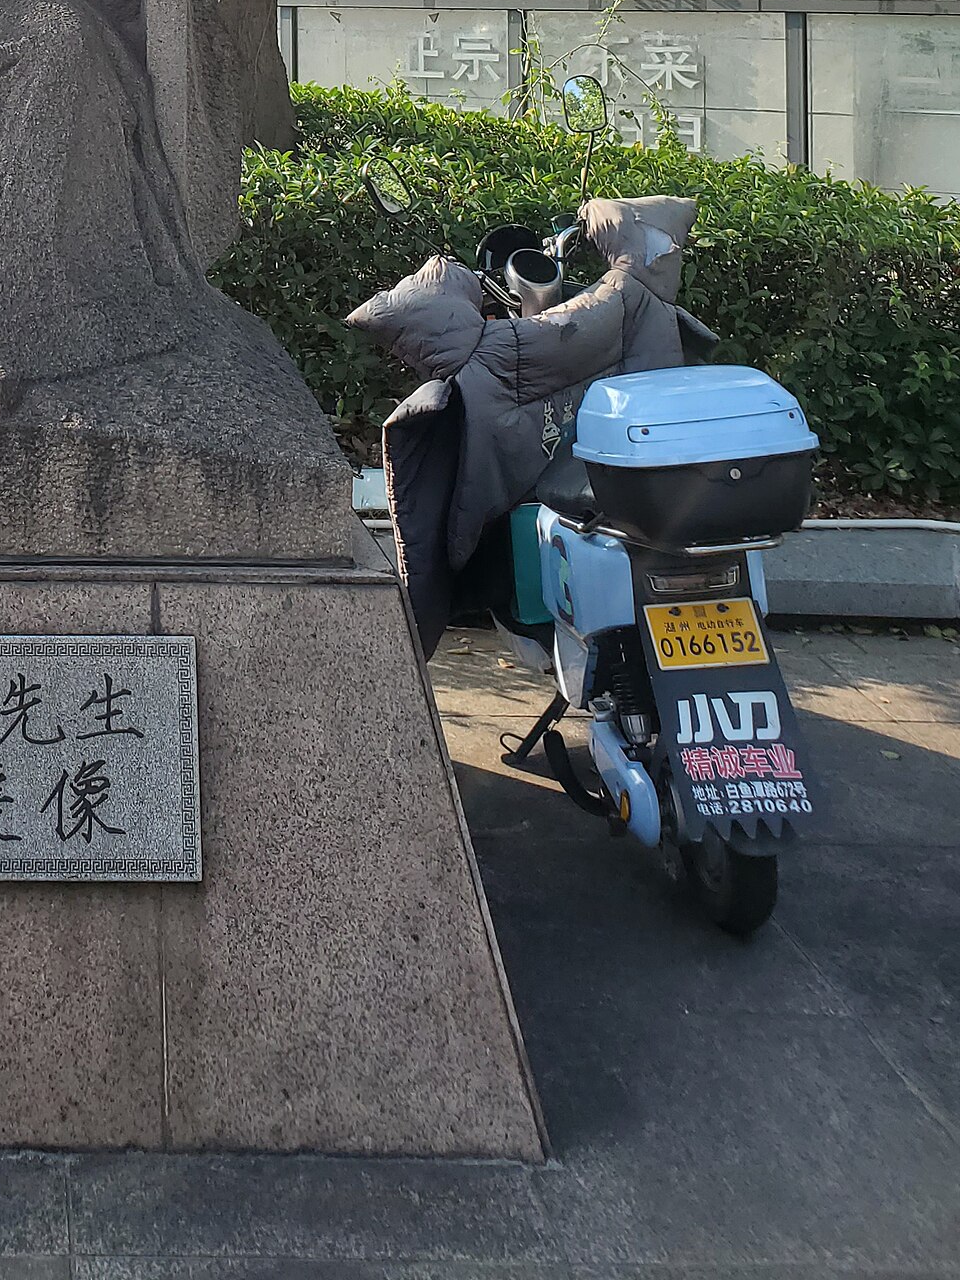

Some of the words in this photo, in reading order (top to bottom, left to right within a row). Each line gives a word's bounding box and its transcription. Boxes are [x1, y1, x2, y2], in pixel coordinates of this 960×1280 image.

[660, 631, 760, 657] 0166152
[677, 690, 782, 744] 小刀
[680, 743, 803, 781] 精诚车业
